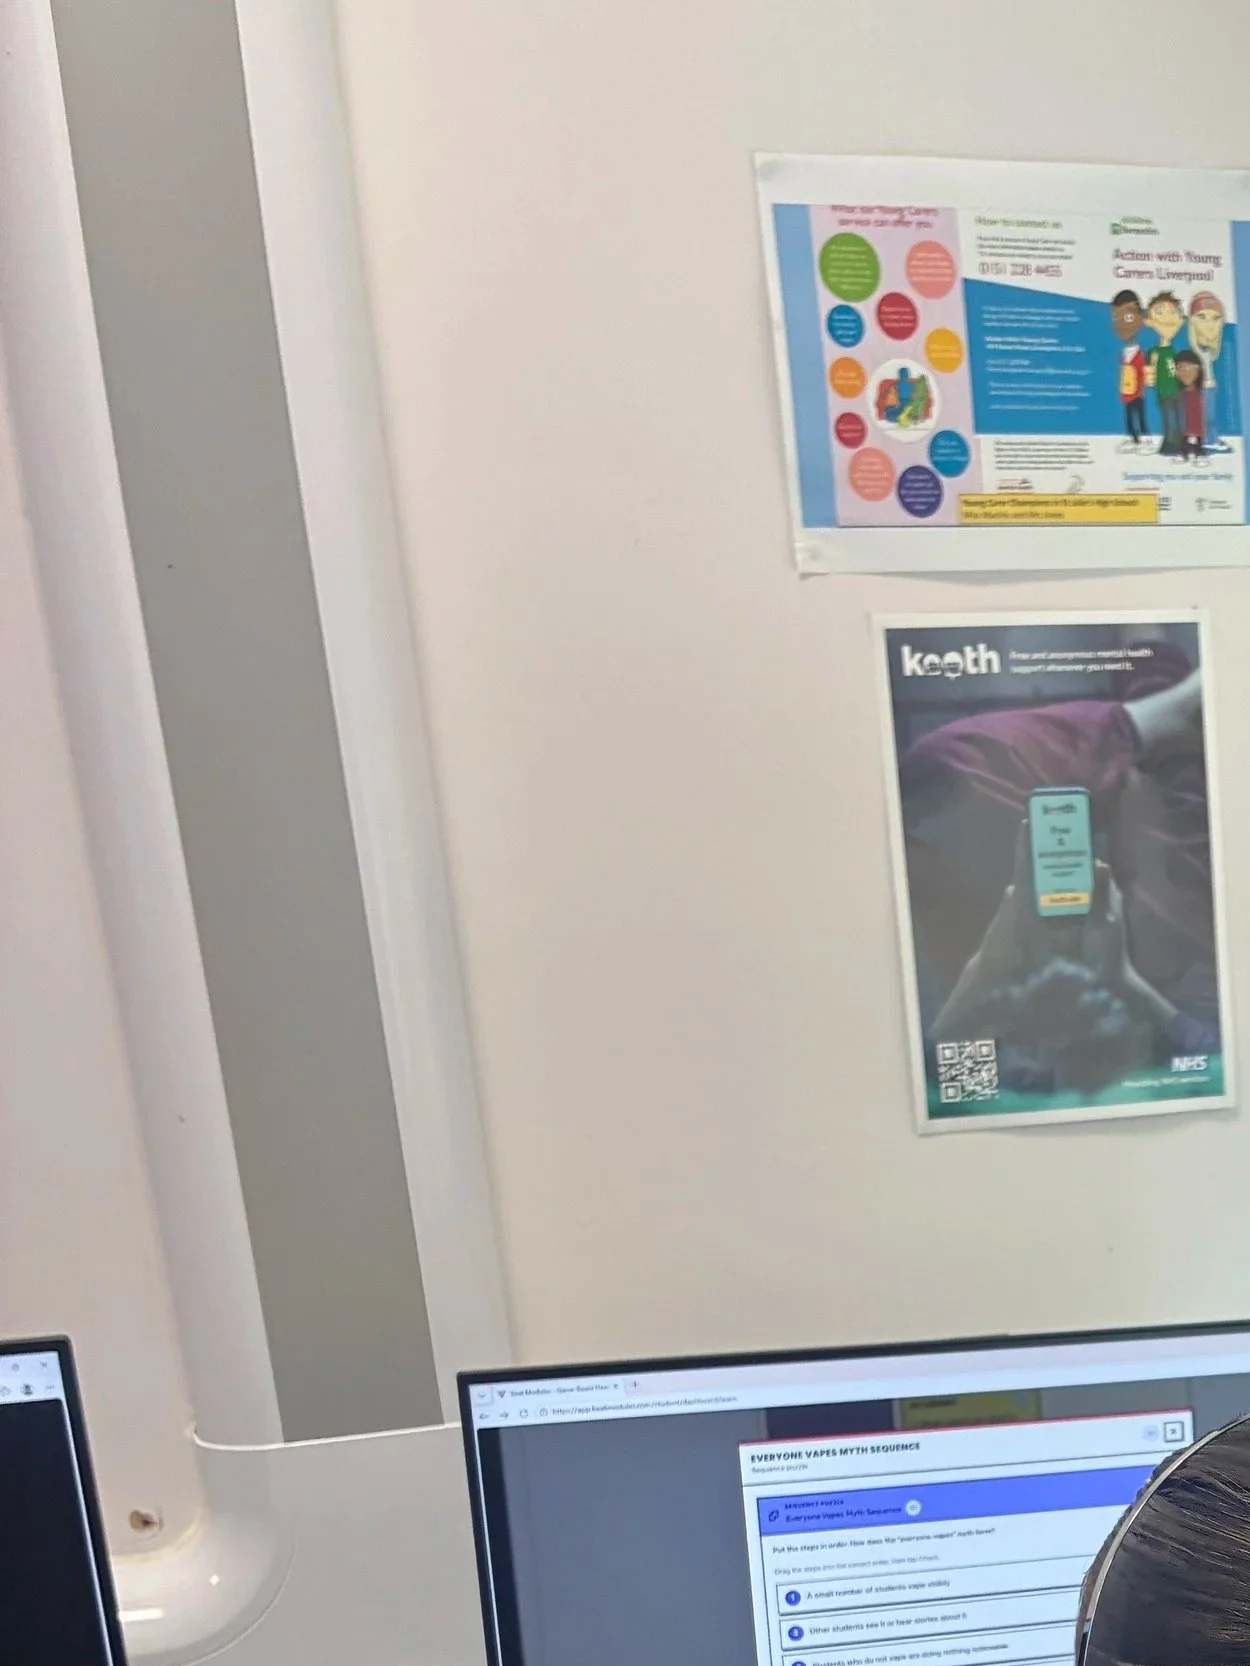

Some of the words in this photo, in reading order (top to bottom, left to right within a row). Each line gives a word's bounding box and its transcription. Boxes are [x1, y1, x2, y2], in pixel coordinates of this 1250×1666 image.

[1112, 249, 1151, 262] Action
[1155, 251, 1183, 263] with
[1184, 251, 1222, 268] Young
[1112, 266, 1154, 280] Carers
[1156, 267, 1214, 284] Liverpool
[901, 643, 1001, 680] kooth
[1172, 1056, 1208, 1071] NHS
[751, 1451, 804, 1464] EVERYONE
[805, 1449, 838, 1461] VAPES
[839, 1446, 869, 1458] MYTH
[870, 1442, 921, 1455] SEQUENCE
[785, 1511, 821, 1524] Everyone
[821, 1510, 845, 1521] Vapes
[846, 1508, 866, 1519] Myth
[866, 1506, 902, 1518] Sequence
[772, 1546, 786, 1555] Put
[786, 1544, 799, 1553] the
[800, 1542, 820, 1553] steps
[849, 1538, 866, 1549] How
[814, 1589, 835, 1599] small
[835, 1587, 864, 1598] number
[864, 1585, 874, 1595] of
[874, 1582, 907, 1594] students
[907, 1582, 926, 1593] vape
[926, 1579, 951, 1591] visibly
[809, 1625, 831, 1636] Other
[832, 1622, 865, 1634] students
[865, 1620, 880, 1629] see
[895, 1616, 913, 1627] hear
[913, 1614, 939, 1626] stories
[939, 1612, 962, 1623] about
[863, 1656, 875, 1666] do
[875, 1654, 888, 1665] not
